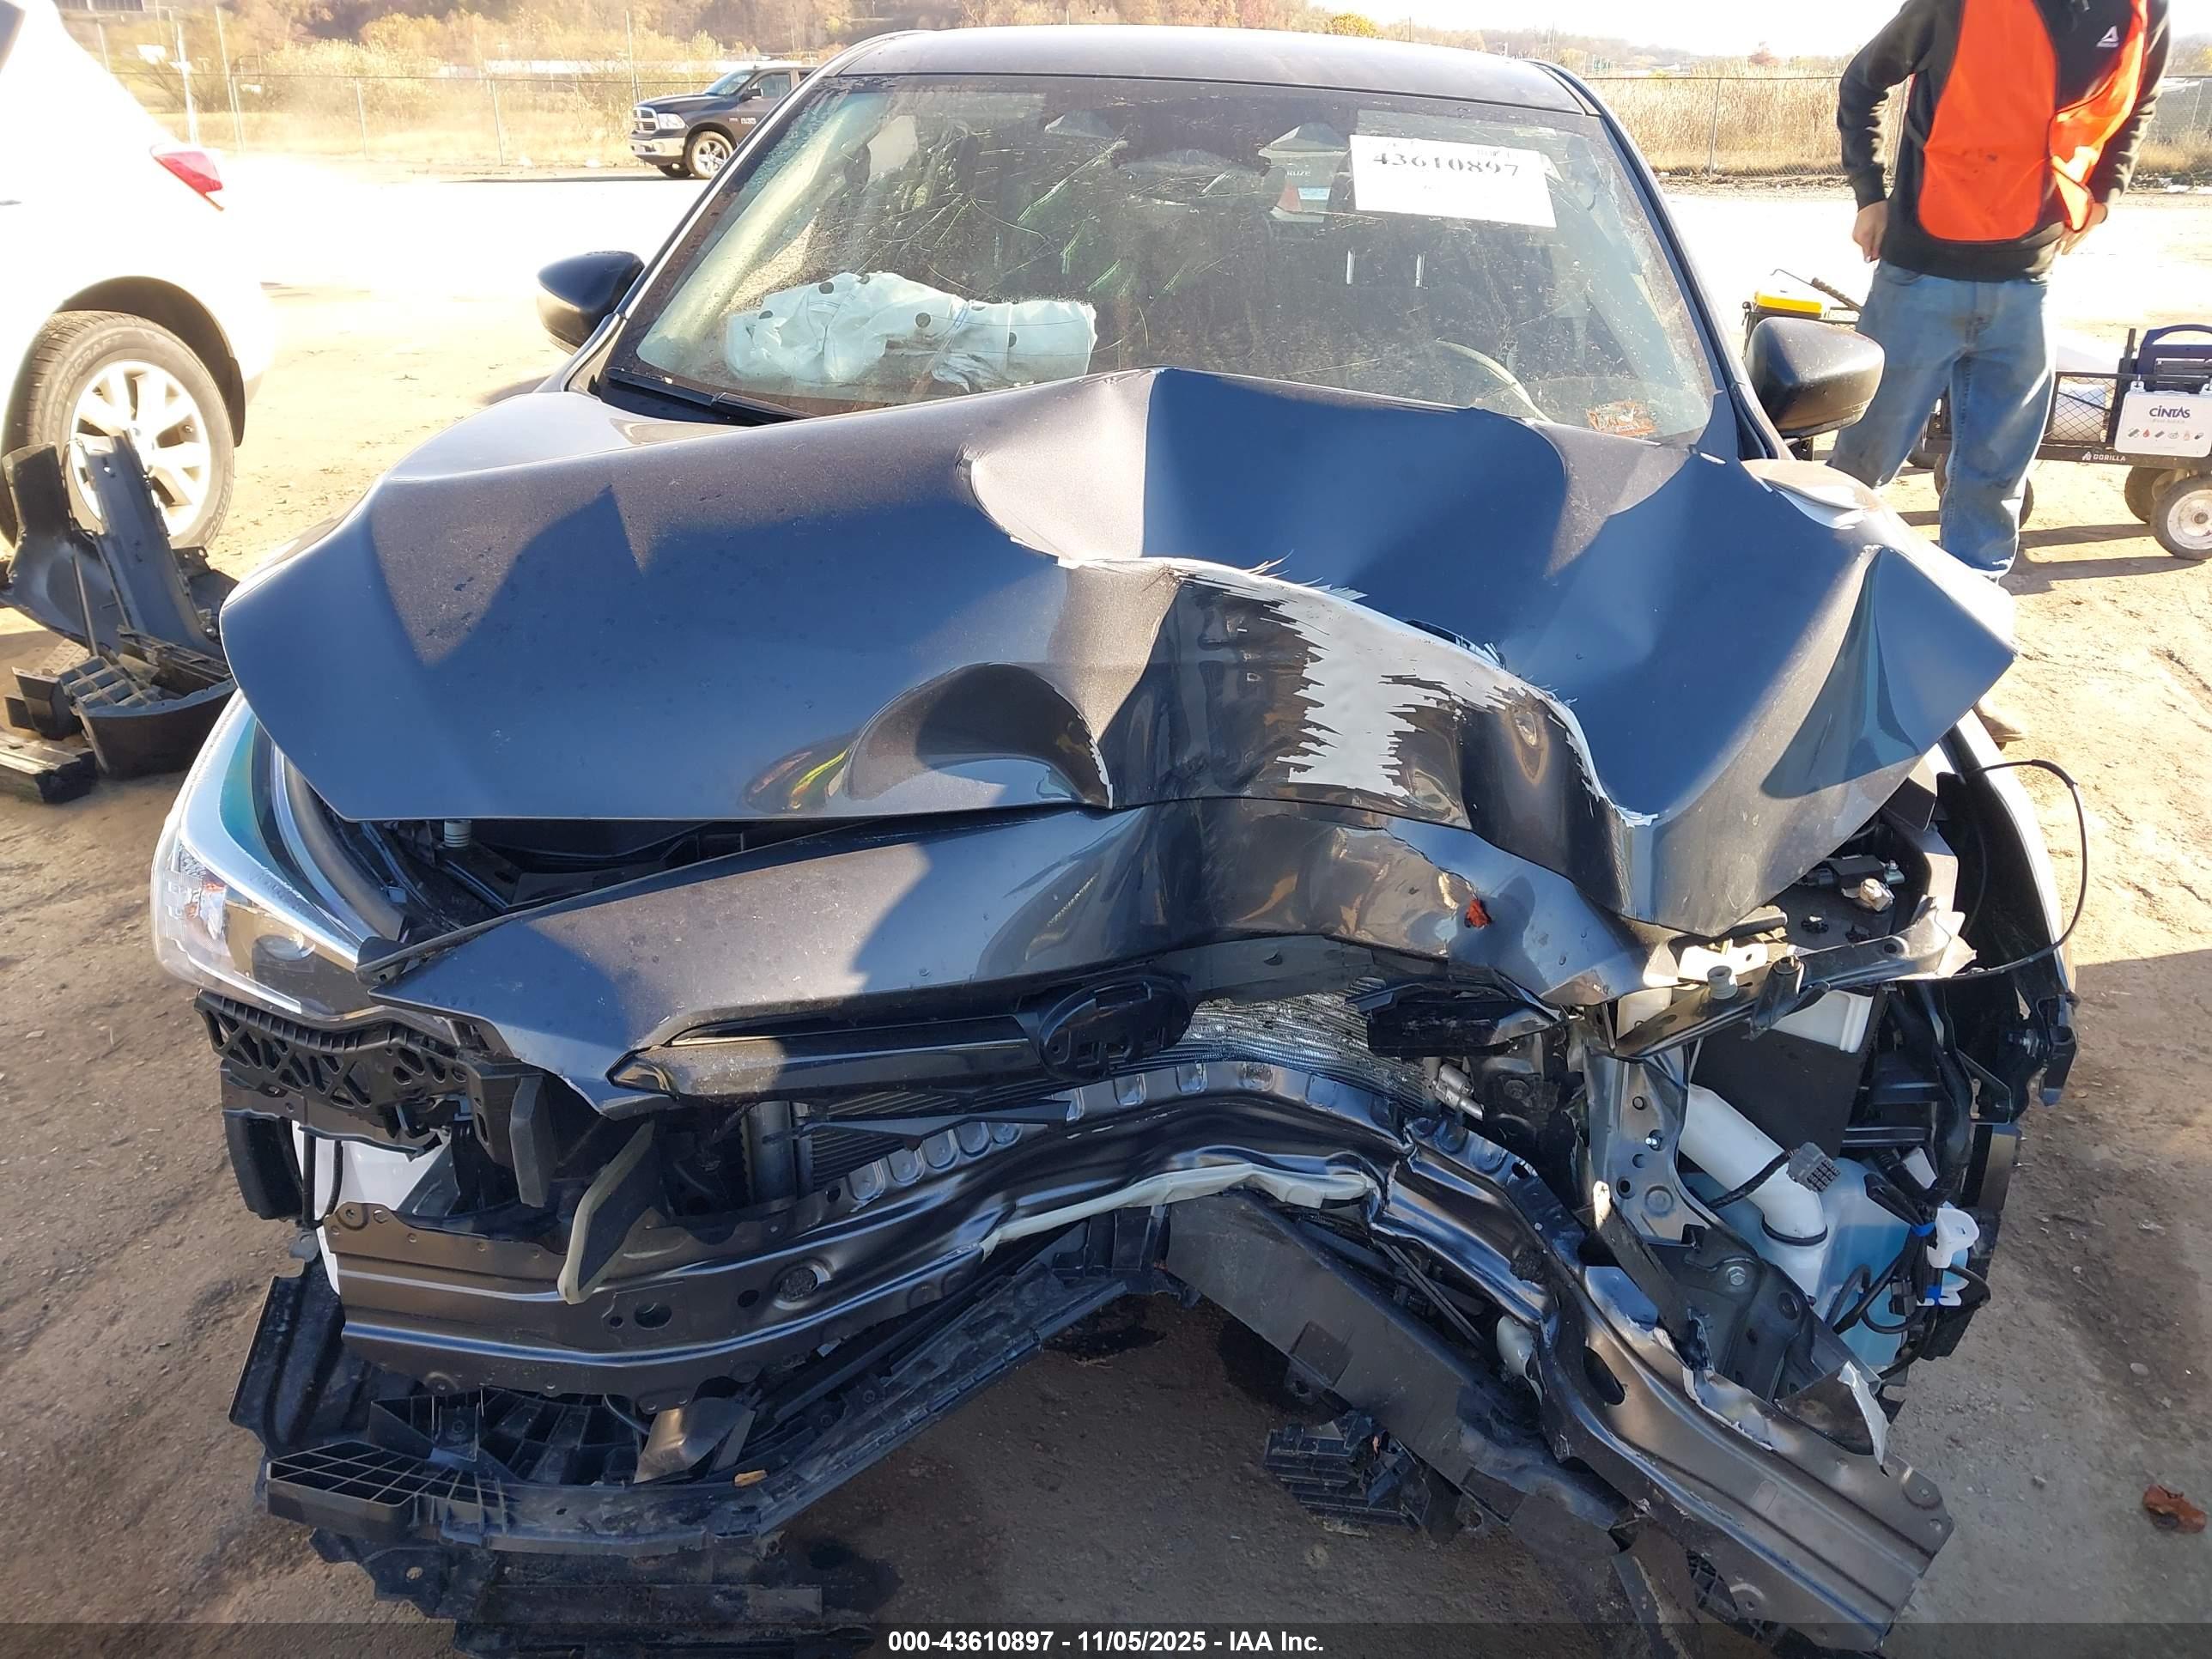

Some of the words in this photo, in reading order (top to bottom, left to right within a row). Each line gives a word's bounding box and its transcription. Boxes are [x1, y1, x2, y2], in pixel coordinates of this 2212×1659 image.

[1371, 152, 1520, 178] 43610897
[2149, 404, 2191, 419] CINTAS
[2093, 453, 2126, 462] GORILLA
